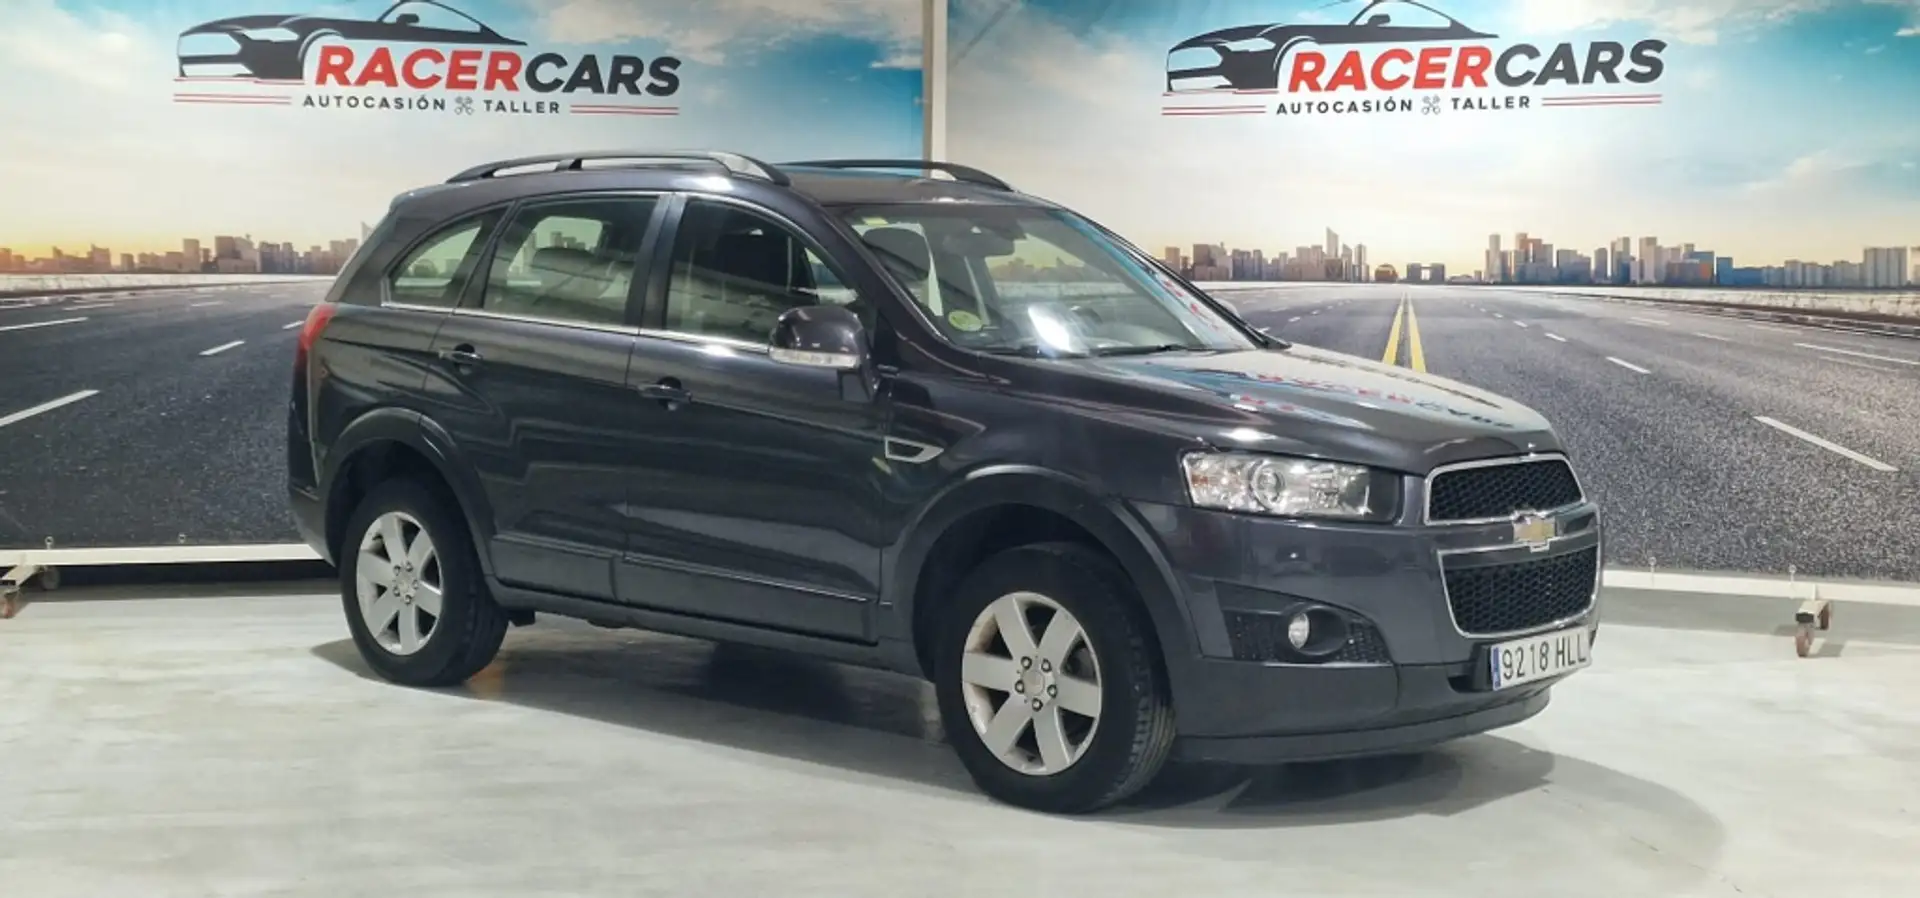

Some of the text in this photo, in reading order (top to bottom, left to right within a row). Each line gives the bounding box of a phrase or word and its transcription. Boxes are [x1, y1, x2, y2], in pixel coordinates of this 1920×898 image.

[316, 45, 682, 96] RACERCARS
[1288, 39, 1667, 93] RACERCARS
[302, 94, 560, 114] AUTOCASIÓN TALLER
[1276, 96, 1530, 115] AUTOCASIÓN TALLER
[1502, 634, 1587, 680] 9218 HLL
